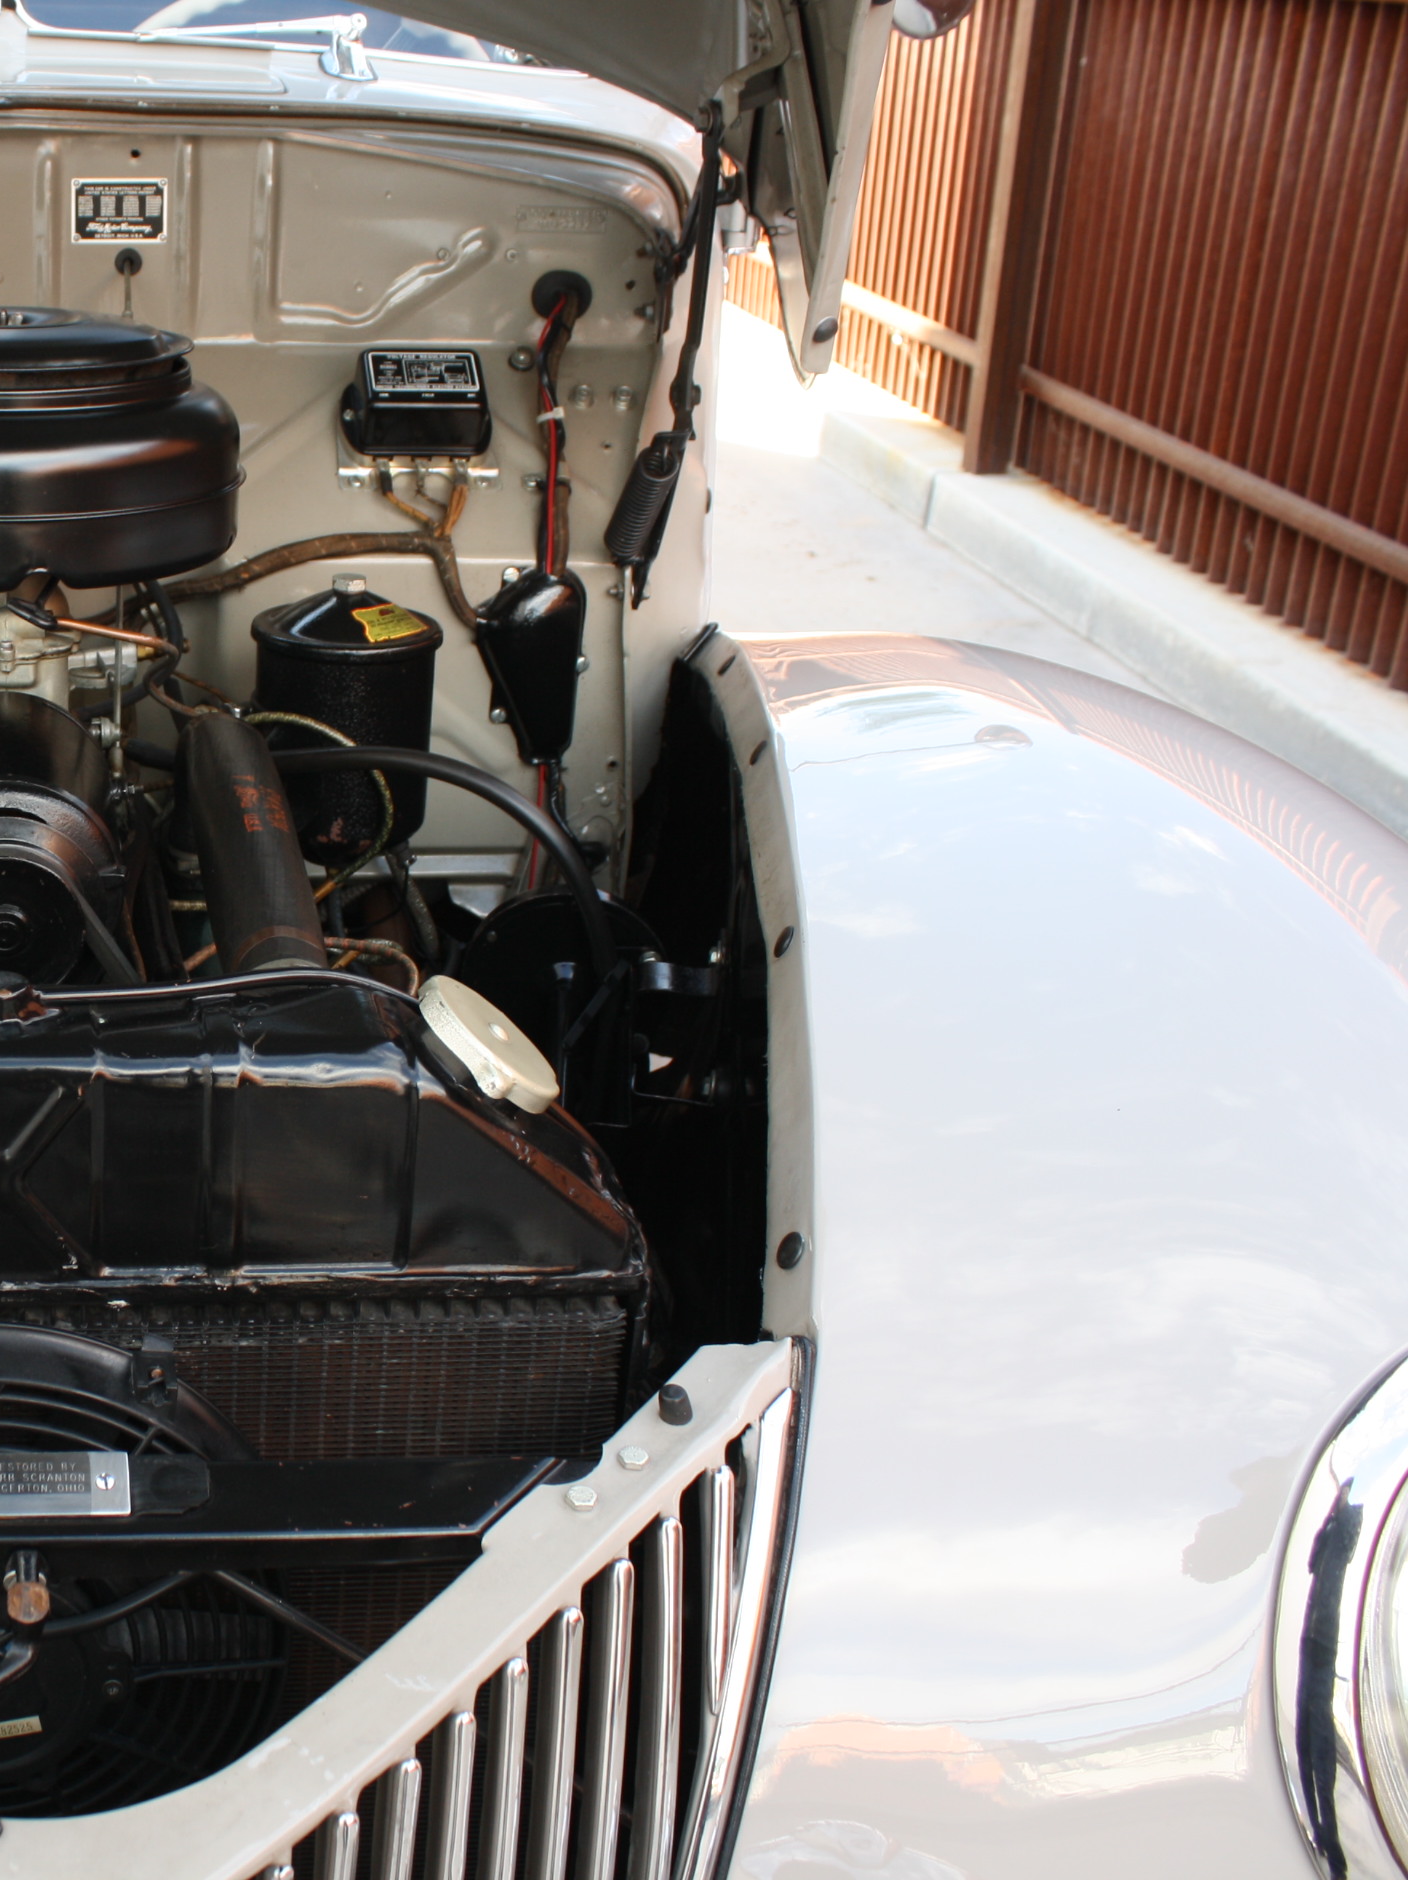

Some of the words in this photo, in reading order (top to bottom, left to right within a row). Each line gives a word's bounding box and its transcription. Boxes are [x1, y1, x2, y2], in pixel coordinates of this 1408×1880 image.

[60, 1462, 76, 1471] BY
[22, 1472, 86, 1482] SCRANTON
[56, 1484, 86, 1493] OHIO
